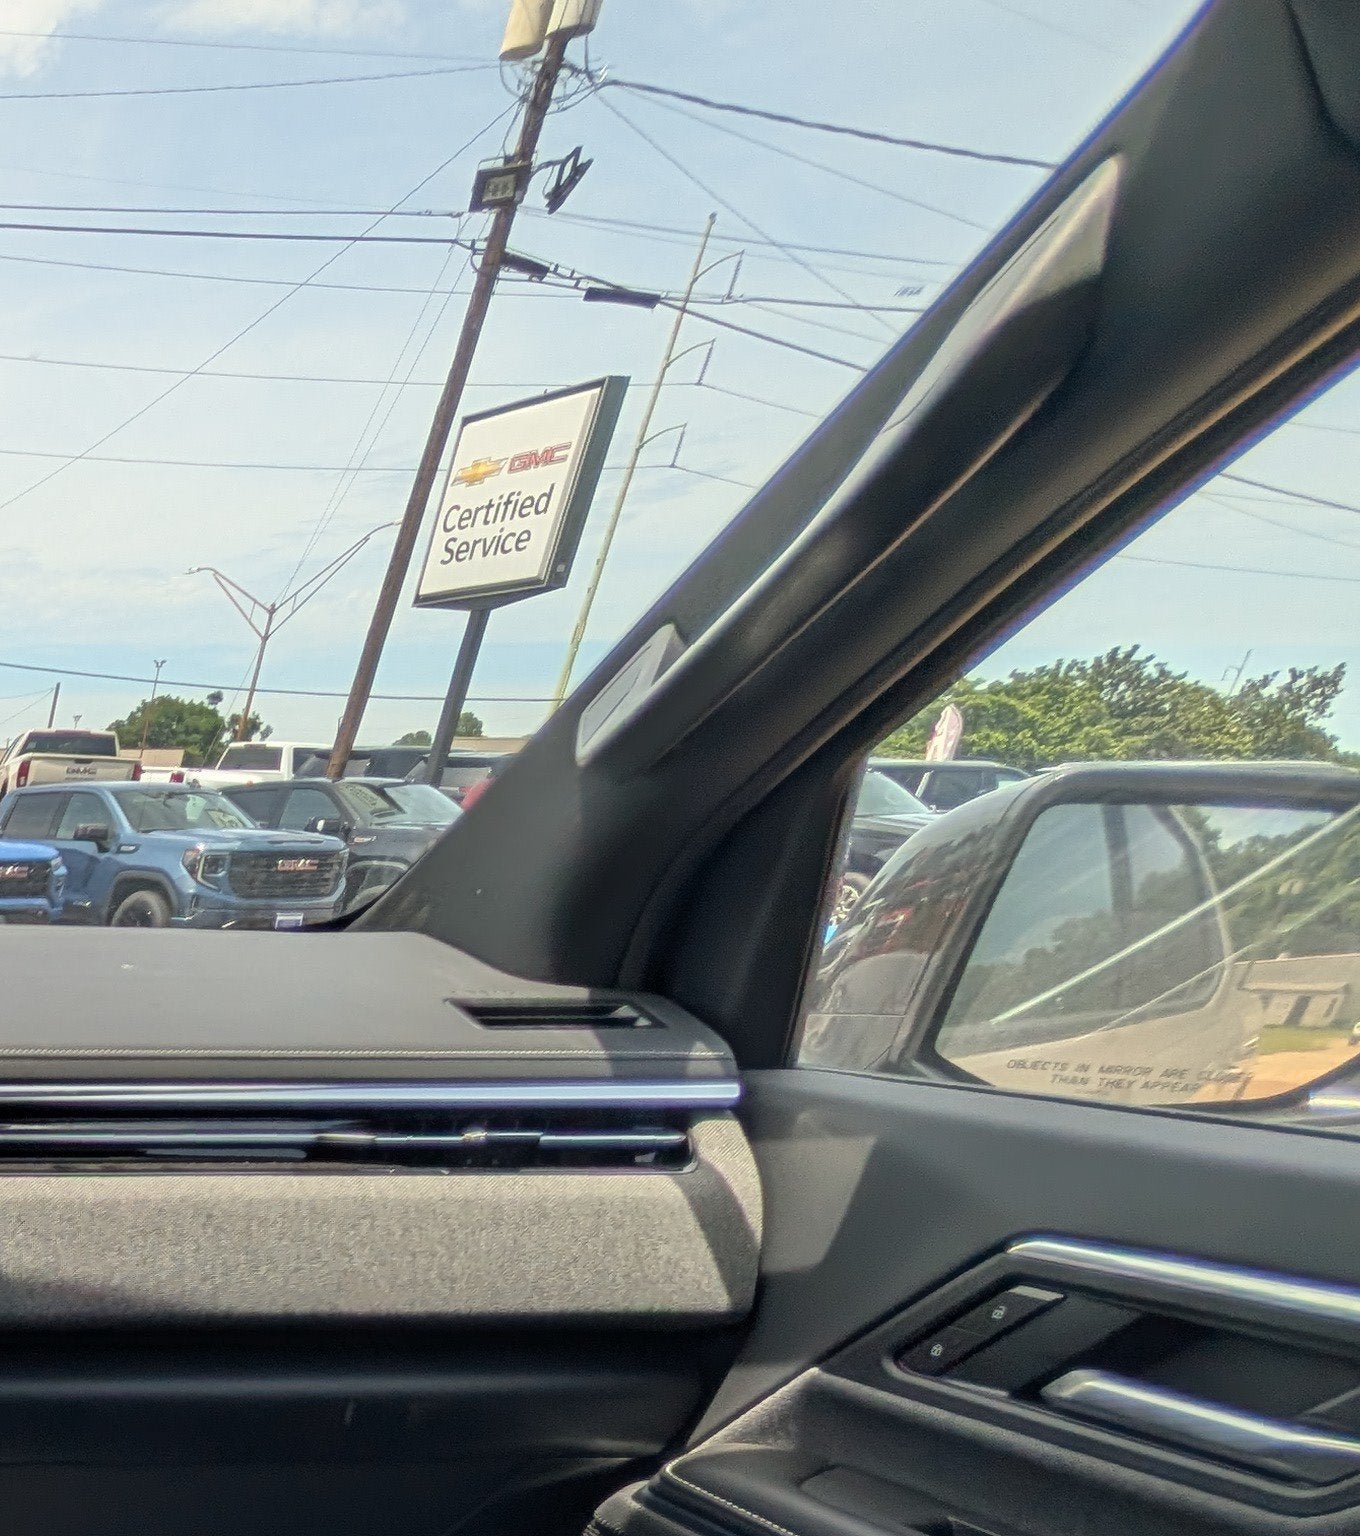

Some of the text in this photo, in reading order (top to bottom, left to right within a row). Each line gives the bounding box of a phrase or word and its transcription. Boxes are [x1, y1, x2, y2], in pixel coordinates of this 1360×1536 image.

[508, 442, 572, 474] GMC
[442, 482, 555, 534] Certified
[440, 527, 532, 566] Service
[1006, 1059, 1069, 1072] OBJECTS
[1074, 1063, 1091, 1073] IN
[1098, 1064, 1154, 1075] MIRROR
[1160, 1068, 1191, 1079] ARE
[1049, 1074, 1090, 1085] THAN
[1098, 1077, 1136, 1089] THEY
